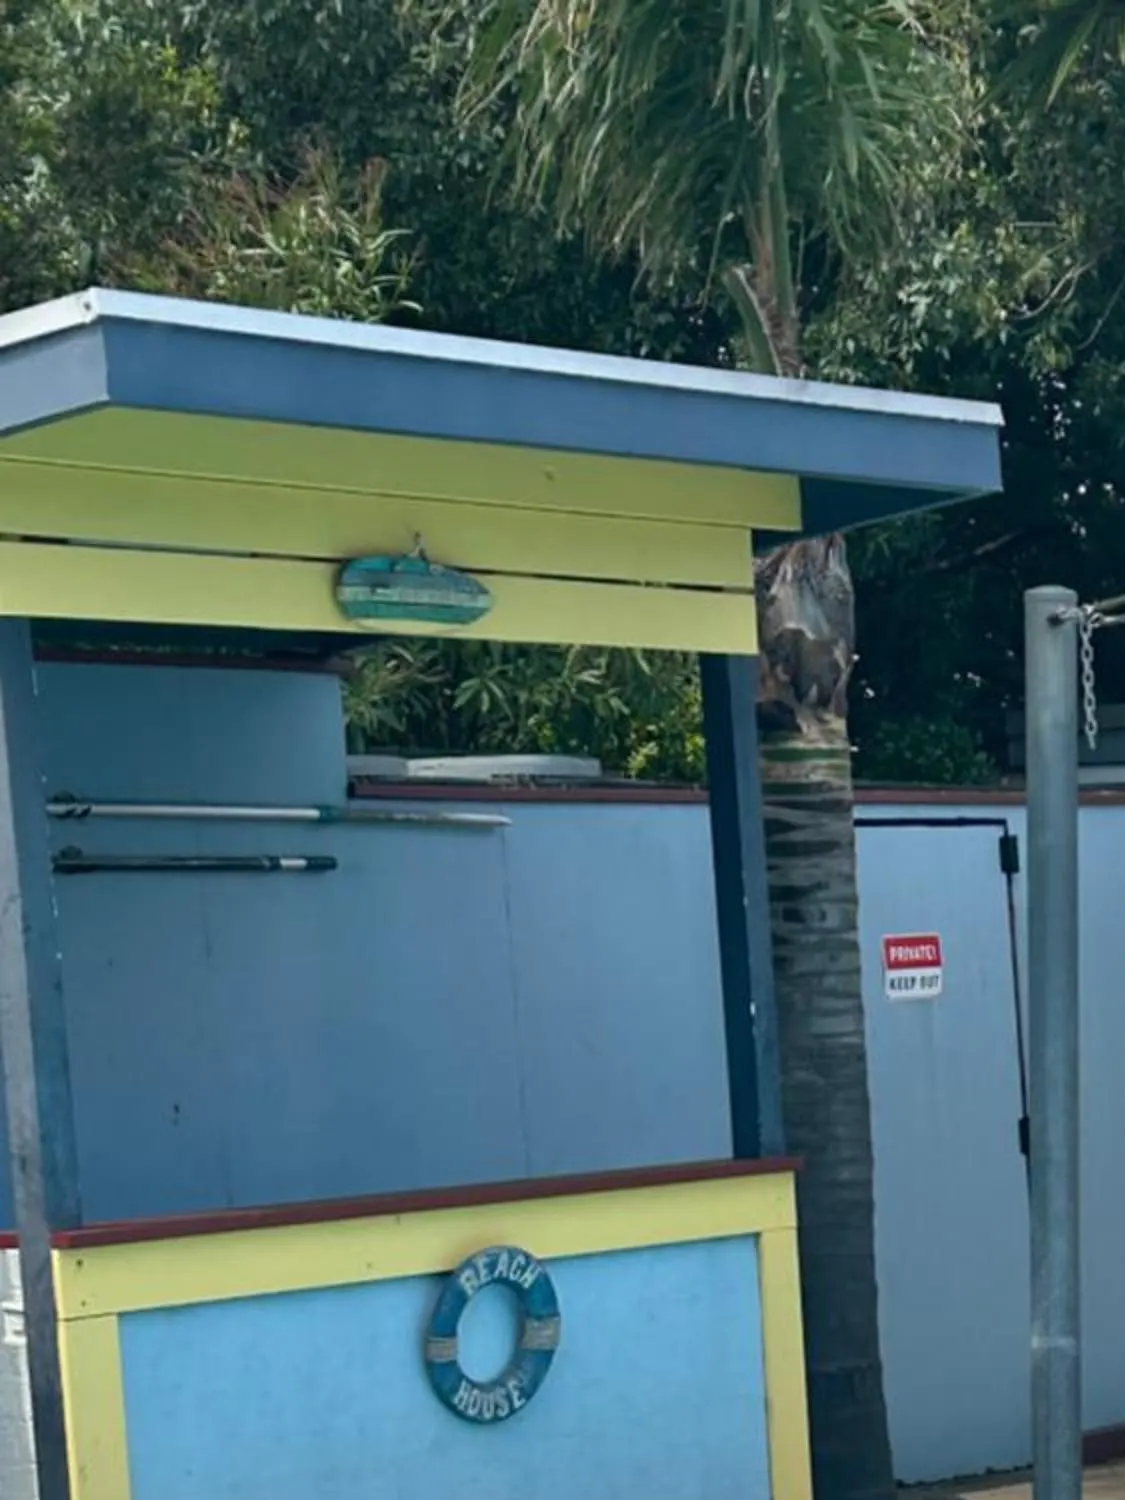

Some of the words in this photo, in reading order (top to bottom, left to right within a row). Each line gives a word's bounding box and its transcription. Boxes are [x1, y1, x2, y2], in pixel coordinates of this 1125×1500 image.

[889, 975, 916, 991] KEEP
[920, 974, 939, 989] OUT
[459, 1251, 542, 1296] BEACH
[453, 1379, 526, 1420] HOUSE
